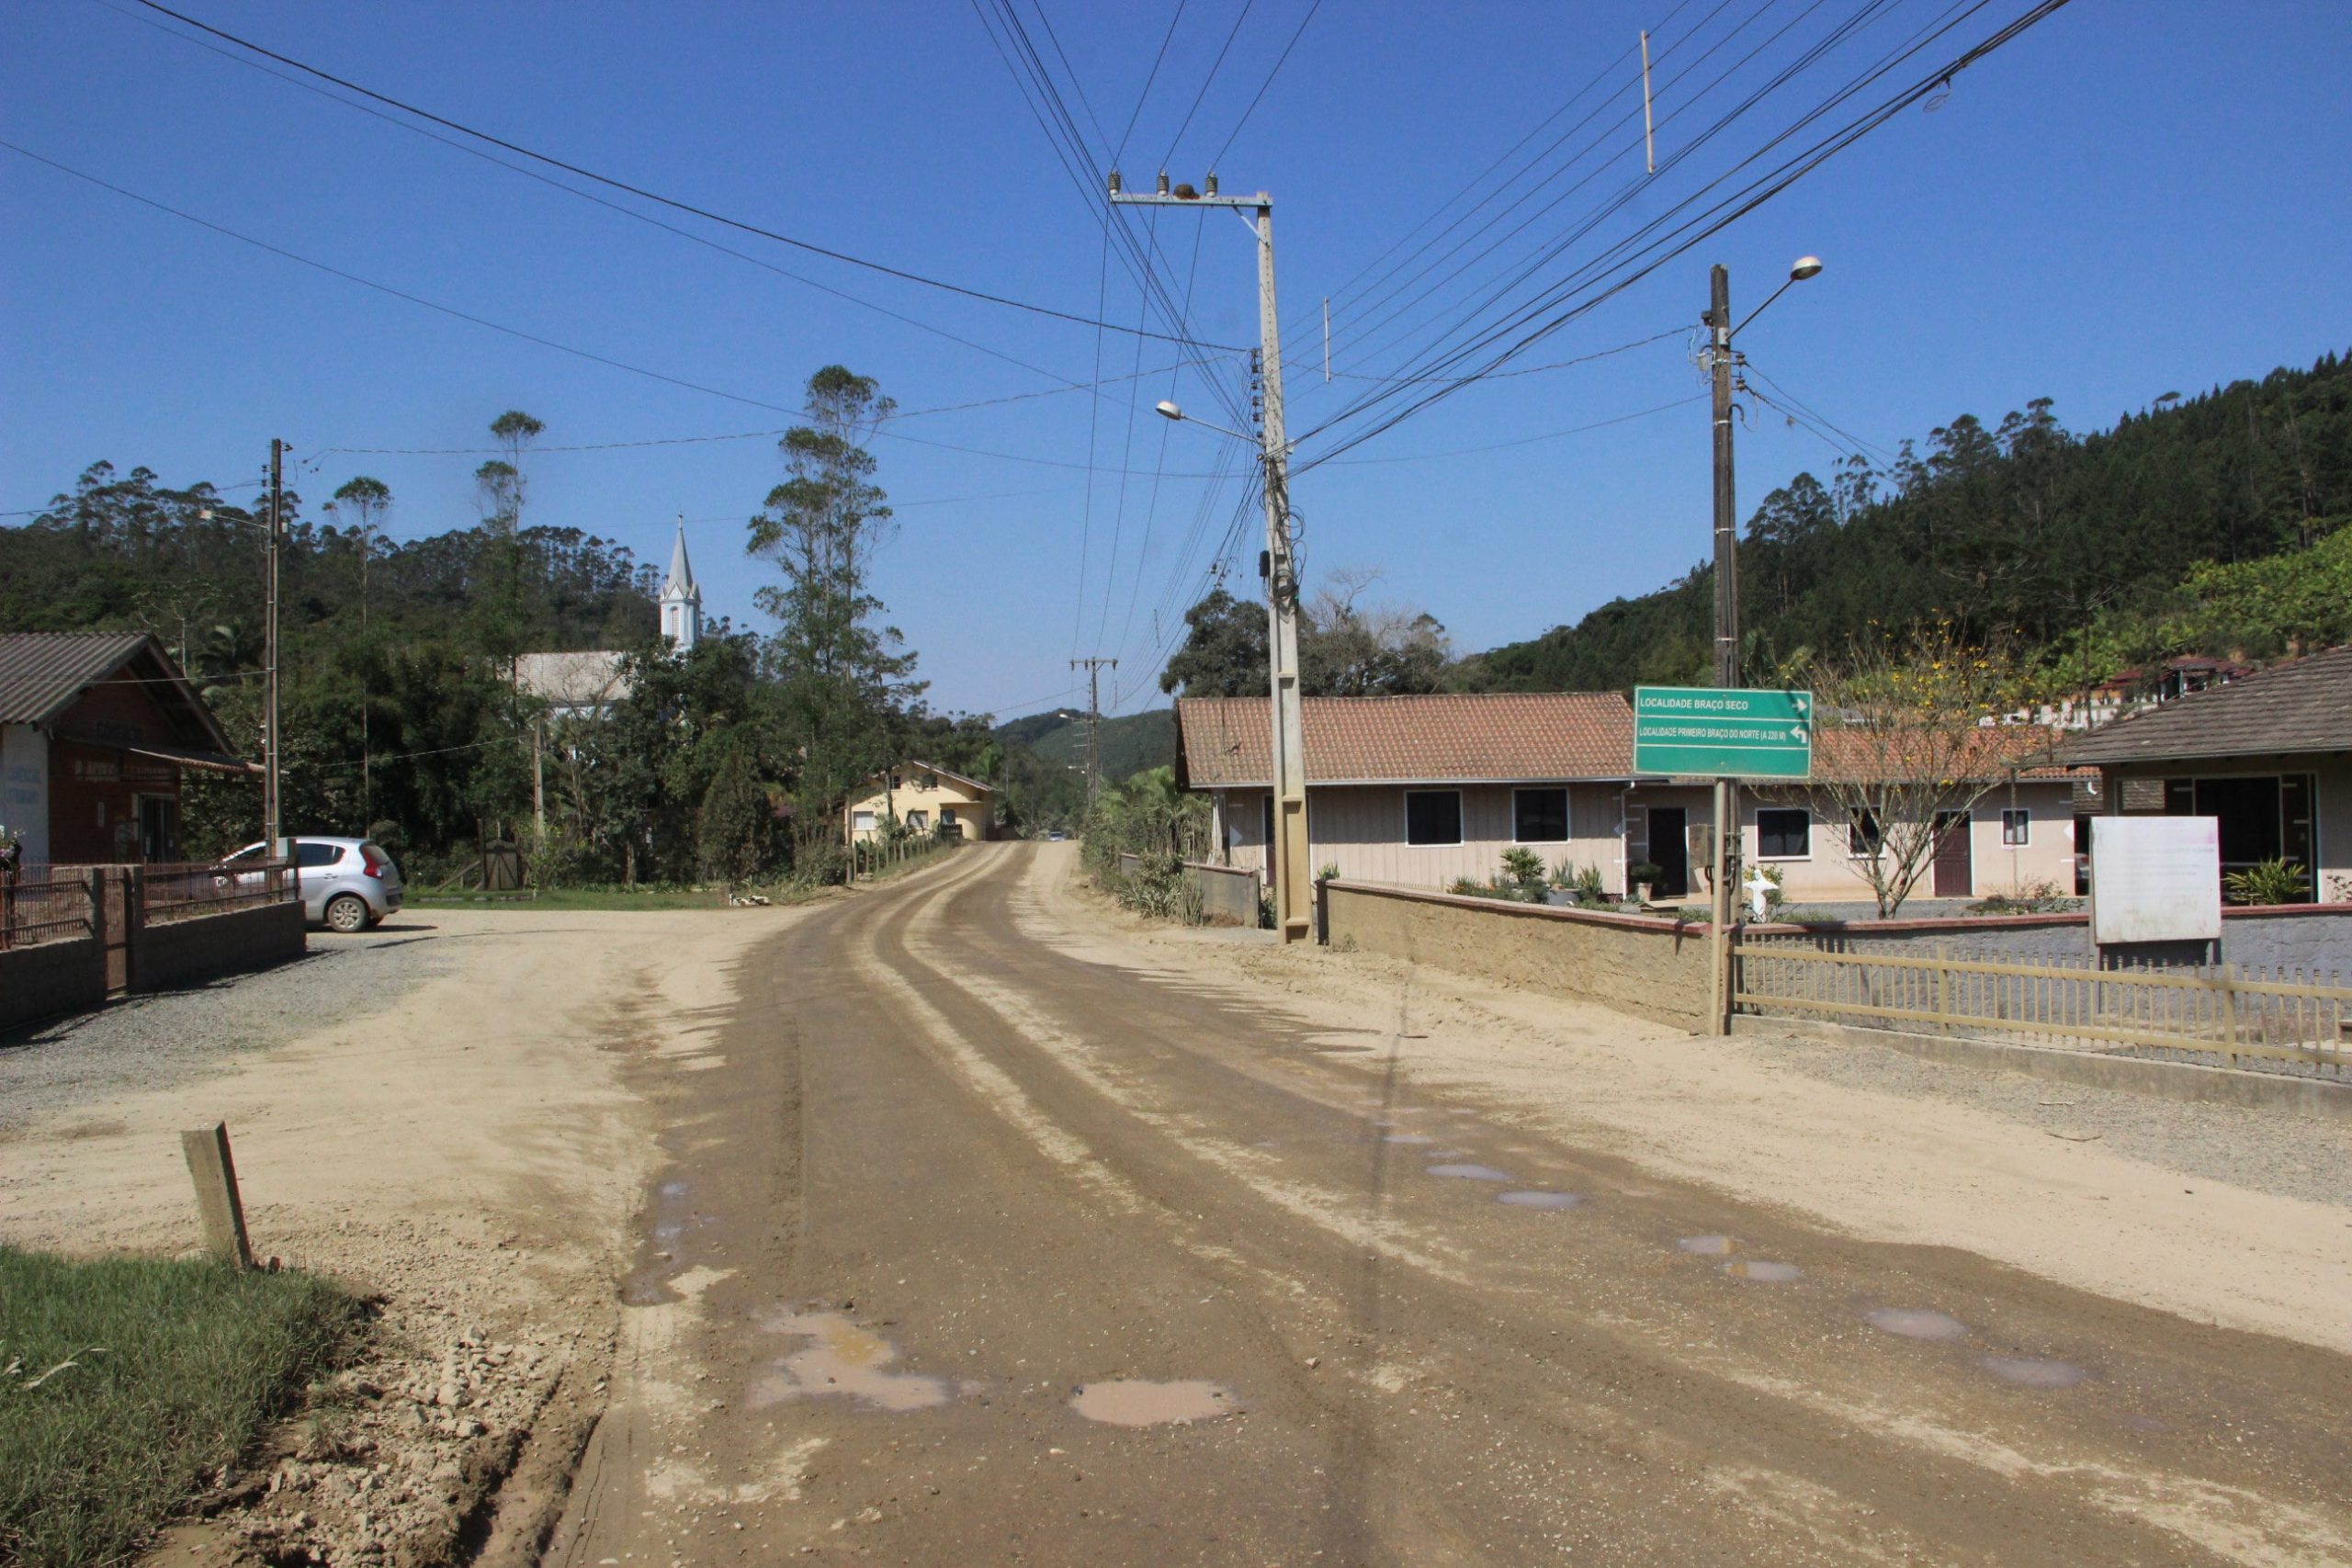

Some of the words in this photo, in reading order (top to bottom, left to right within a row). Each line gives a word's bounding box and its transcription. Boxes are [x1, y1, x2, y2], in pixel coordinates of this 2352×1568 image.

[1640, 698, 1692, 709] LOCALIDADE
[1694, 700, 1723, 711] BRAÇO
[1725, 701, 1748, 710] SECO
[1639, 728, 1677, 737] LOCALIDADE
[1738, 730, 1759, 739] NORTE
